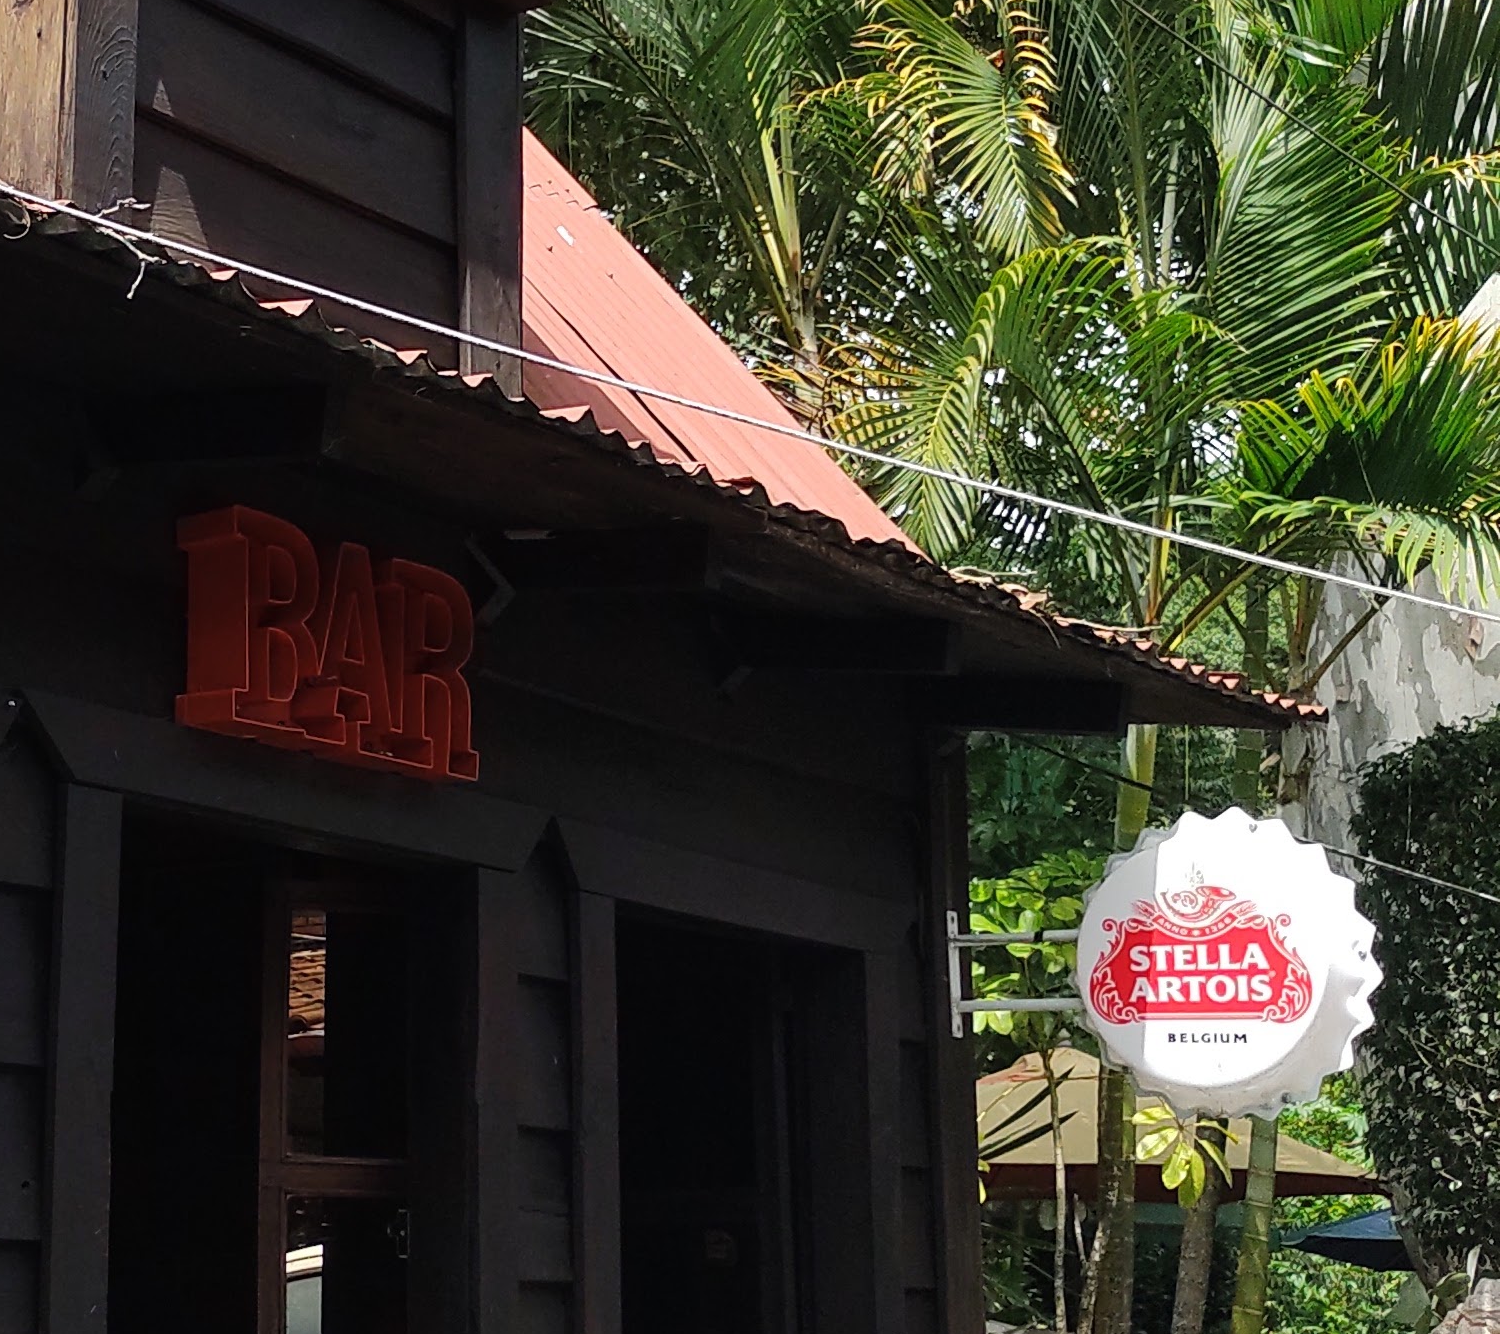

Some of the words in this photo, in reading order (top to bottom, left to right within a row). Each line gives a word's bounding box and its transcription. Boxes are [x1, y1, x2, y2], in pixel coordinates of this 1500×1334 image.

[176, 505, 479, 781] BAR
[1129, 943, 1271, 972] STELLA
[1128, 974, 1273, 1004] ARTOIS
[1168, 1033, 1248, 1044] BELGIUM
